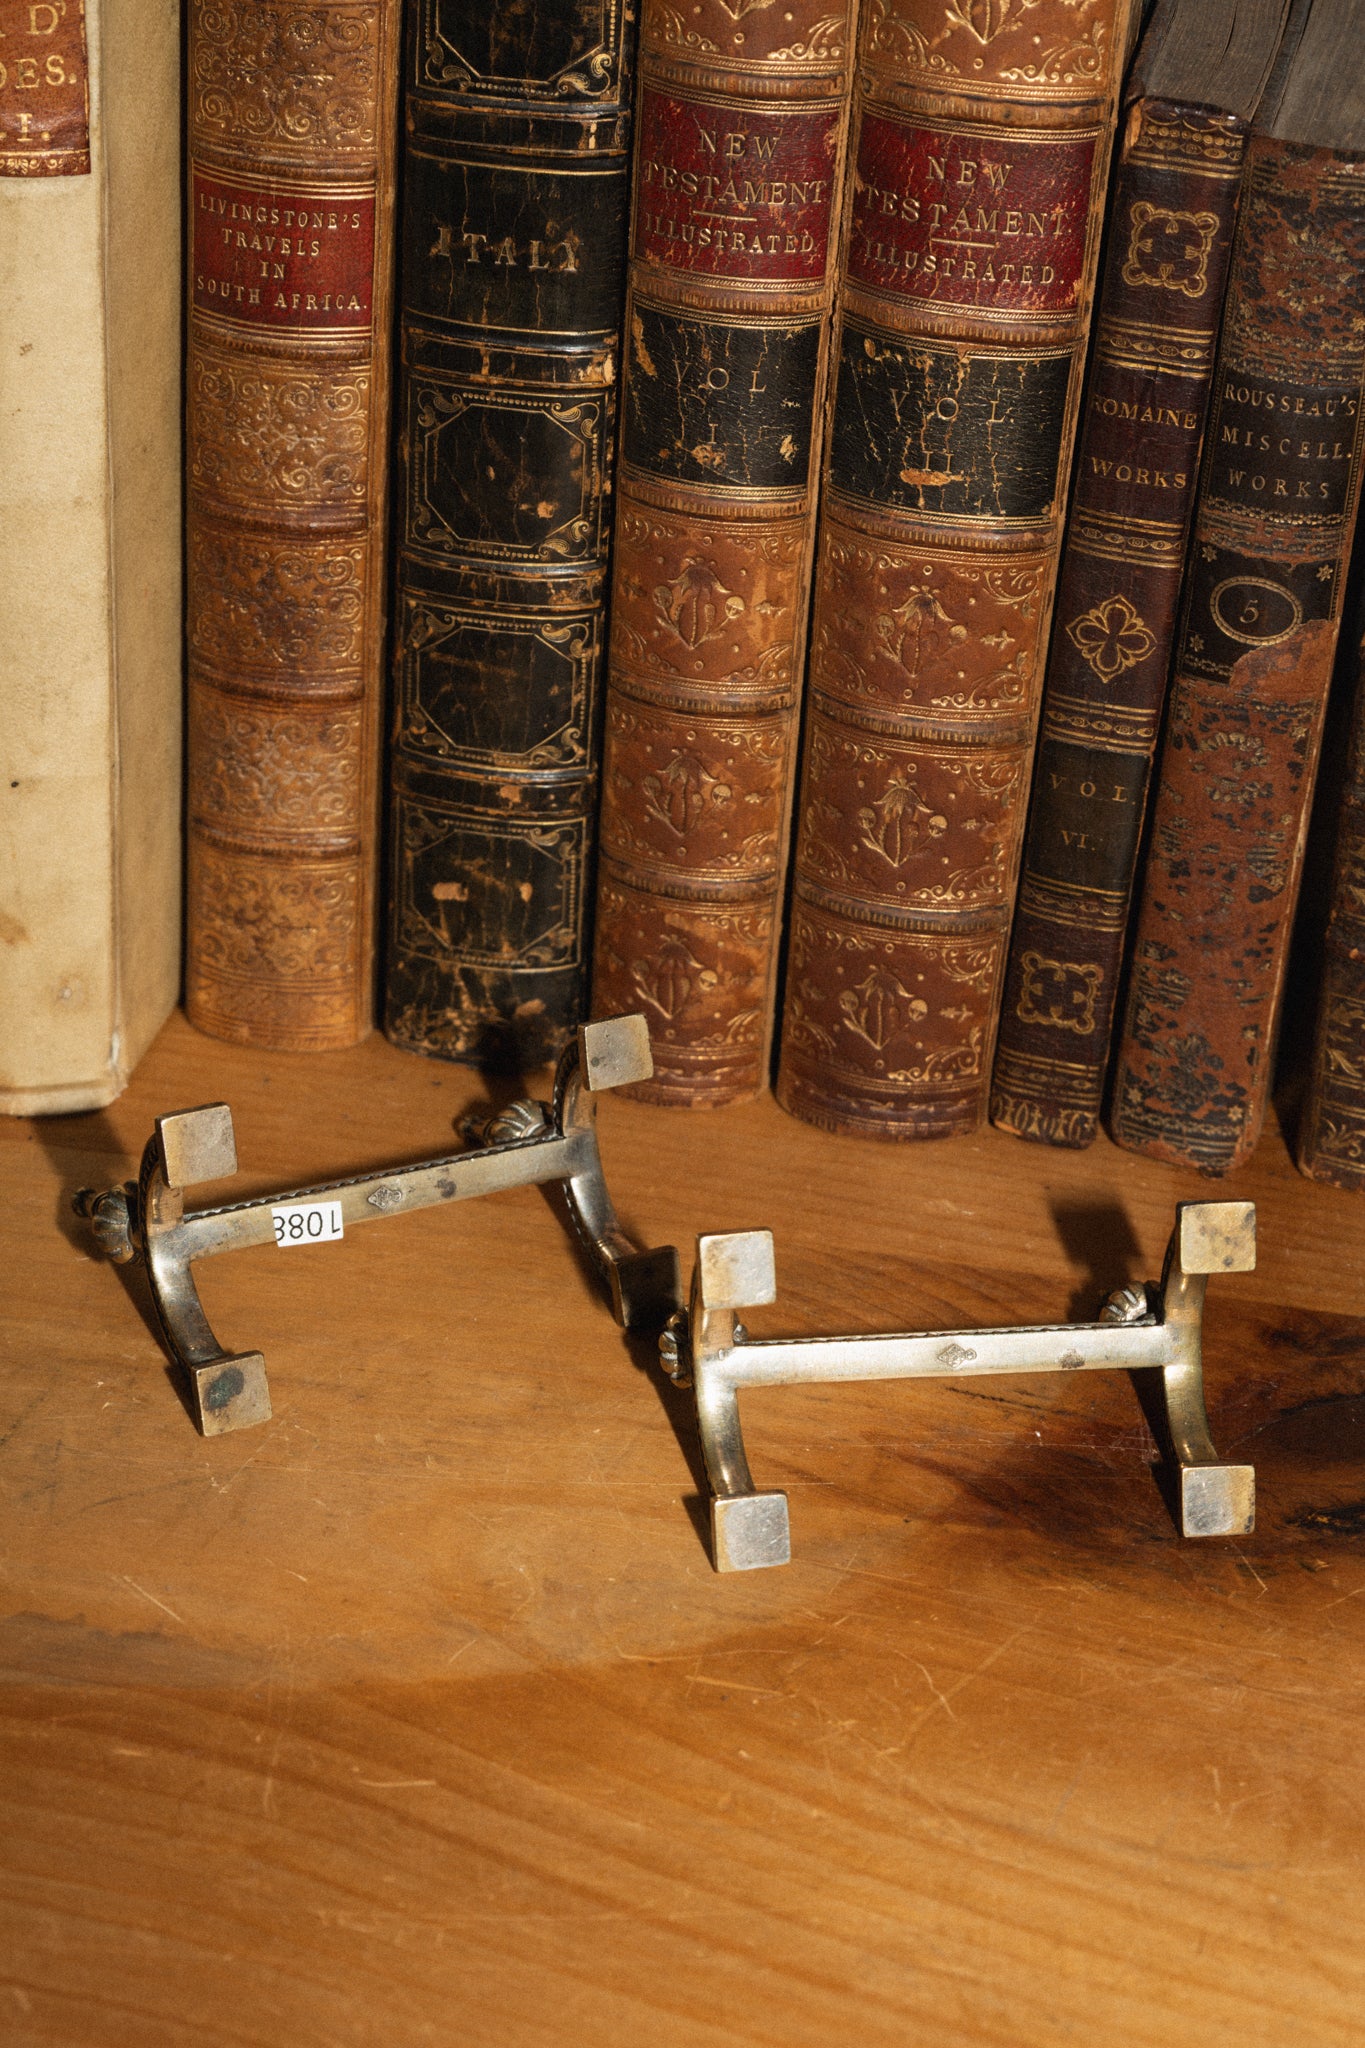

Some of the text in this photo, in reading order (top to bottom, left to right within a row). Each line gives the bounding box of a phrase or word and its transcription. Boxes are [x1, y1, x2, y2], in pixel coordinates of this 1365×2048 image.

[698, 129, 780, 159] NEW
[644, 160, 827, 205] TESTAMENT
[926, 156, 1014, 187] NEW
[200, 193, 361, 229] LIVINGSTONE'S
[865, 184, 1072, 236] TESTAMENT.
[222, 228, 320, 256] TRAVELS
[437, 226, 584, 273] ITALY
[260, 261, 285, 279] IN
[866, 239, 1065, 285] ILLUSTRATED.
[197, 275, 367, 311] SOUTH AFRICA.
[1225, 383, 1357, 417] ROUSSEAU'S
[1221, 425, 1353, 459] MISCELL.
[1091, 457, 1187, 489] WORKS
[1229, 469, 1329, 498] WORKS
[1239, 600, 1259, 623] 5
[1050, 773, 1136, 805] VOL.
[1061, 830, 1096, 851] VI.
